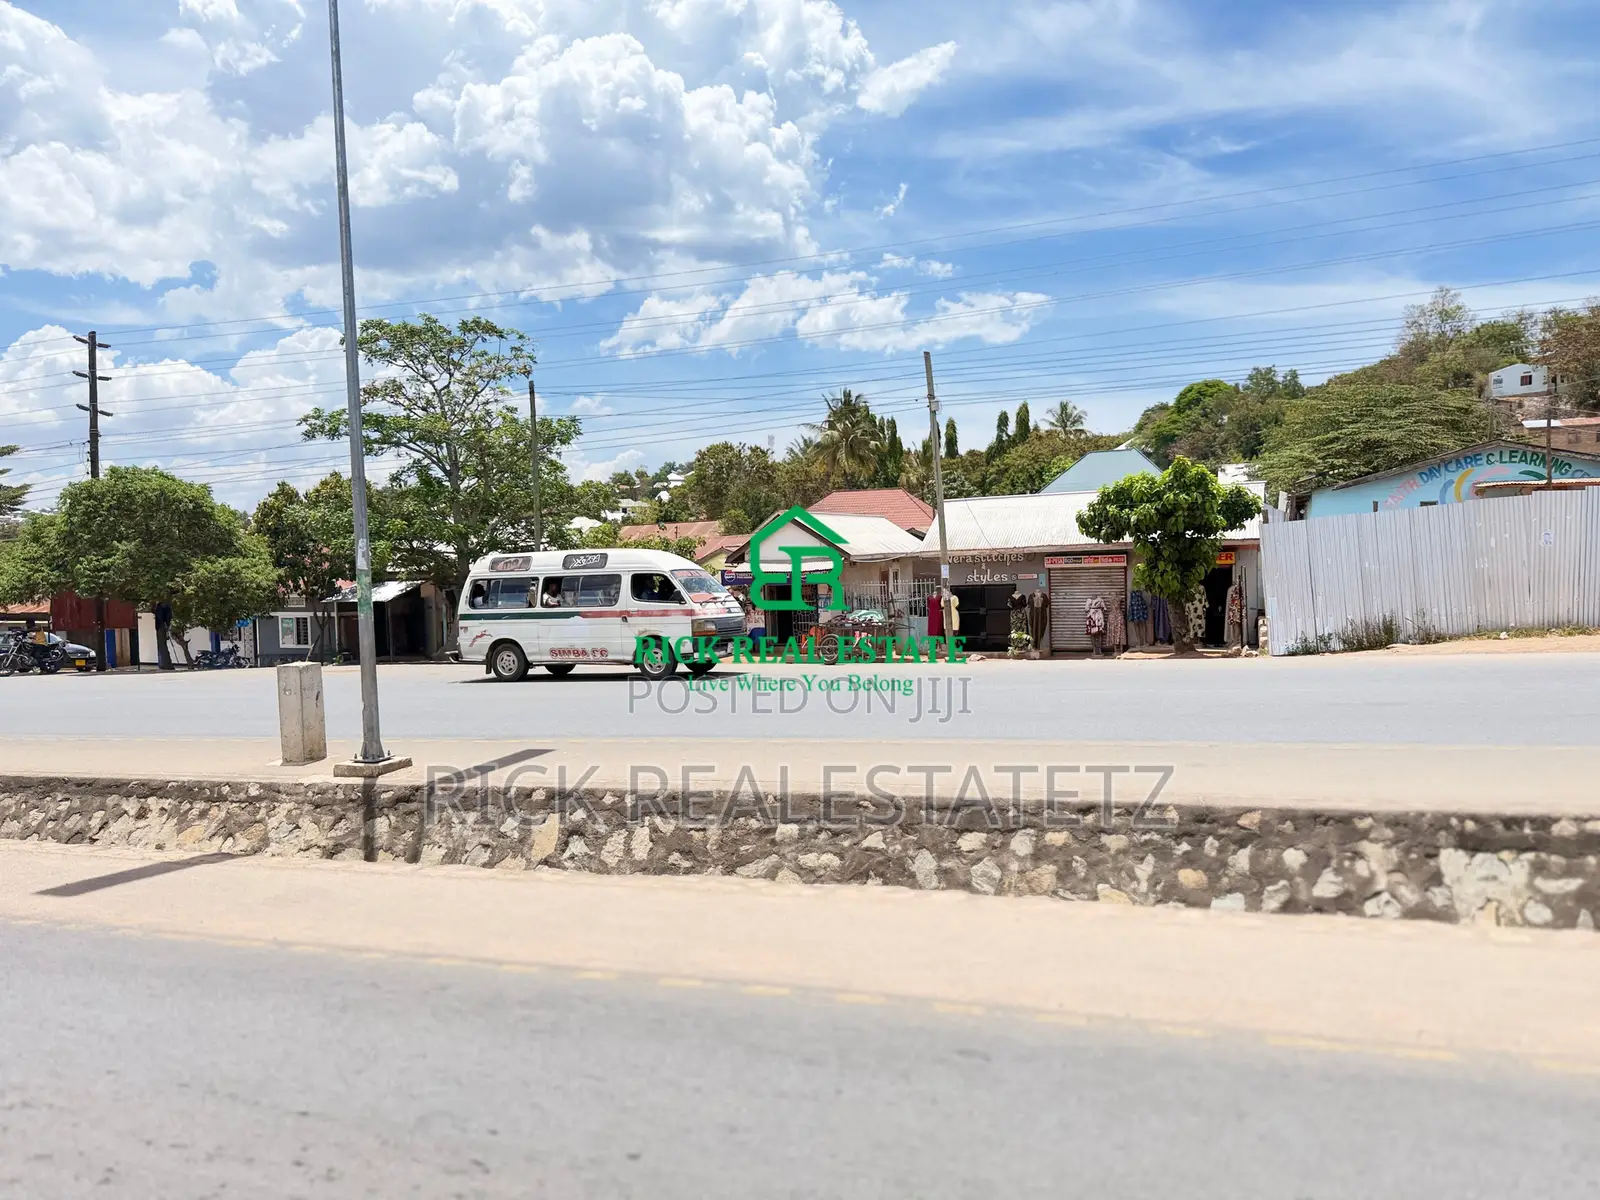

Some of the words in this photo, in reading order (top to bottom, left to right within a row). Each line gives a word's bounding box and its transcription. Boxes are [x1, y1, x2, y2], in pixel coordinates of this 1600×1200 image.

[1418, 463, 1442, 483] DAY
[1443, 453, 1484, 474] CARE
[1486, 453, 1498, 465] &
[966, 569, 1008, 584] styles
[549, 648, 591, 659] SIMBA
